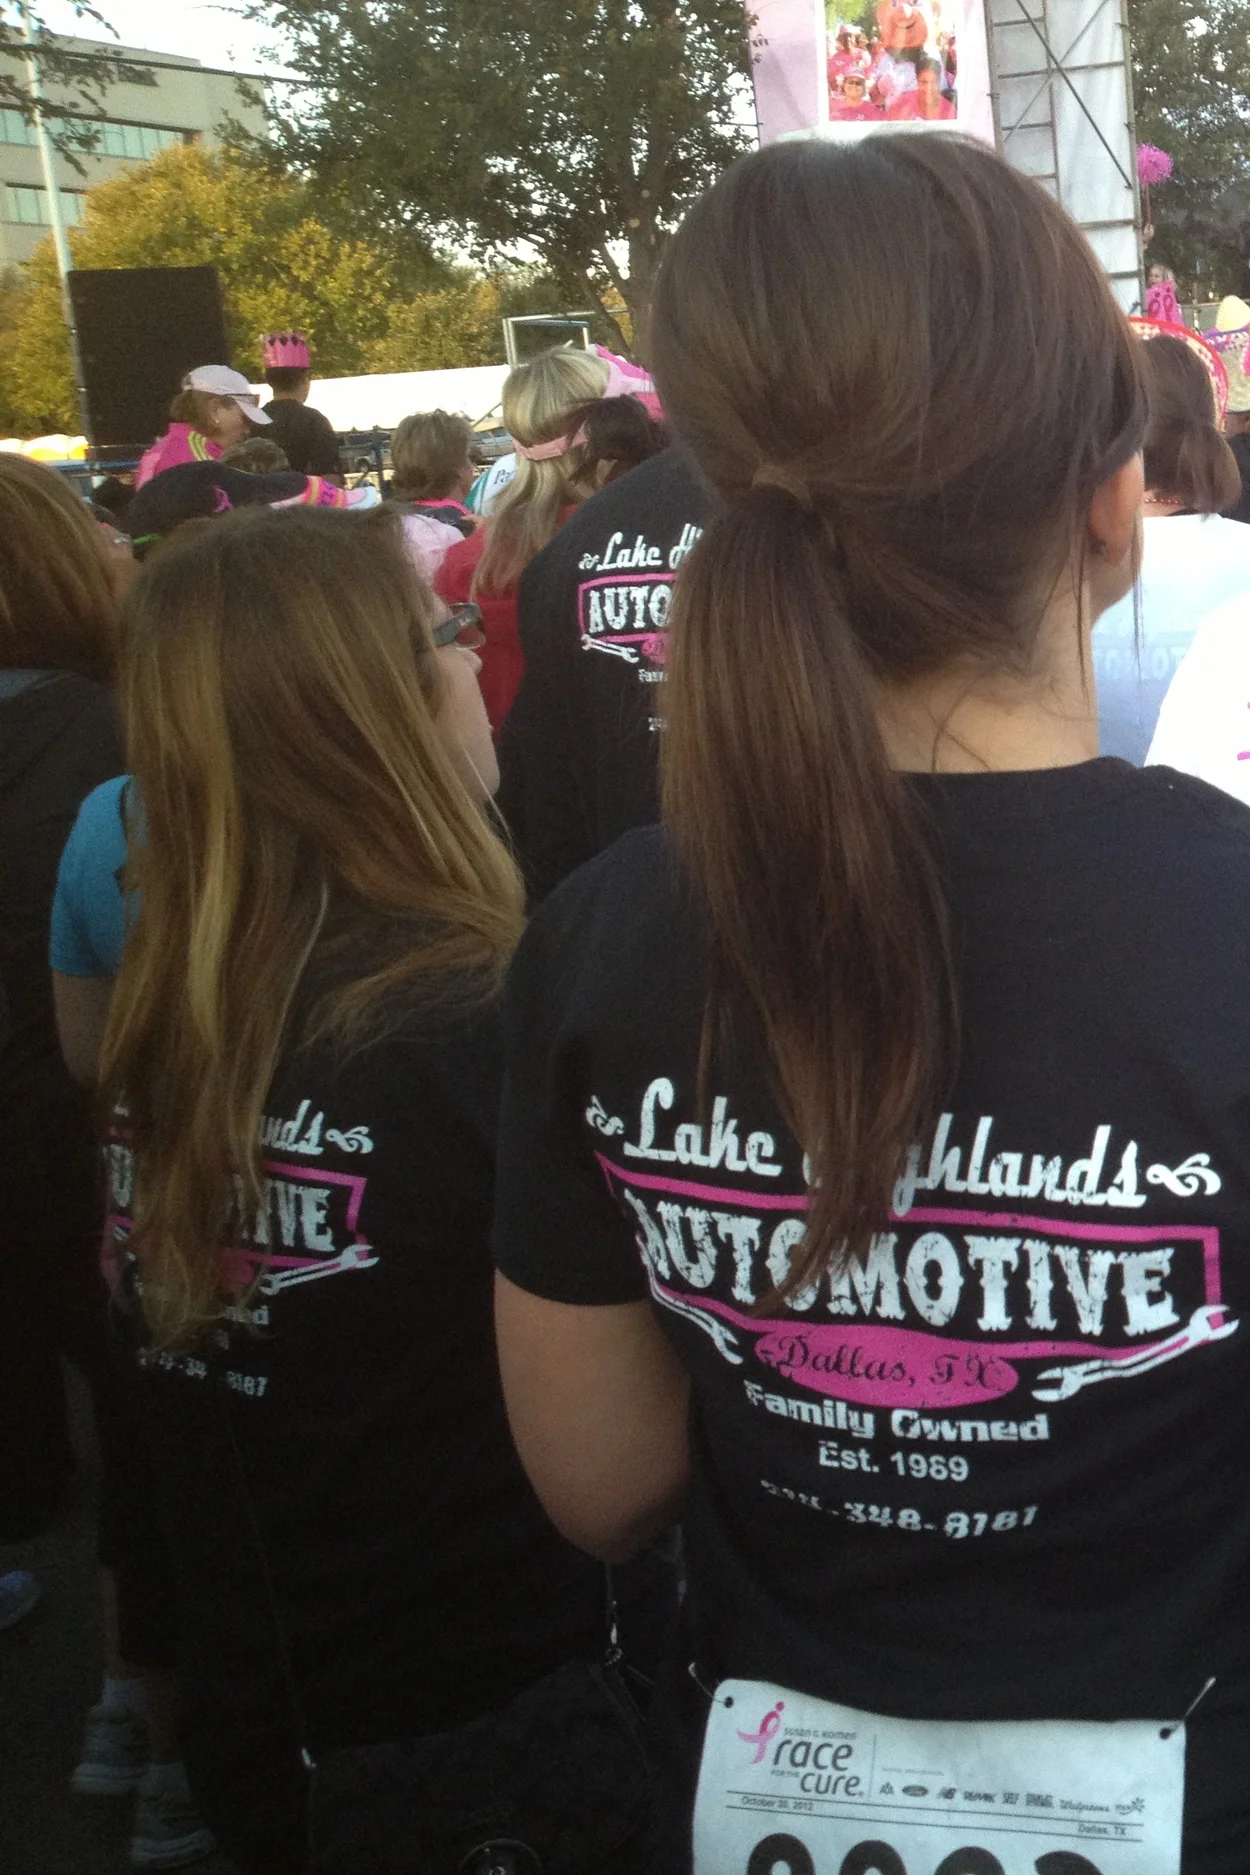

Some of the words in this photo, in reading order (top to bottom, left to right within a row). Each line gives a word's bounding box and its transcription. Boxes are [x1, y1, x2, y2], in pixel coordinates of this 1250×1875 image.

[596, 531, 663, 571] Lake
[623, 1076, 783, 1177] Lake
[803, 1112, 1148, 1218] ghlands
[623, 1188, 1181, 1337] AUTOMOTIVE
[777, 1335, 917, 1388] Dallas,
[929, 1351, 1003, 1389] TX
[743, 1378, 876, 1440] Family
[890, 1408, 1050, 1442] Owned
[818, 1440, 880, 1473] Est.
[890, 1451, 970, 1483] 1969
[773, 1738, 854, 1772] race
